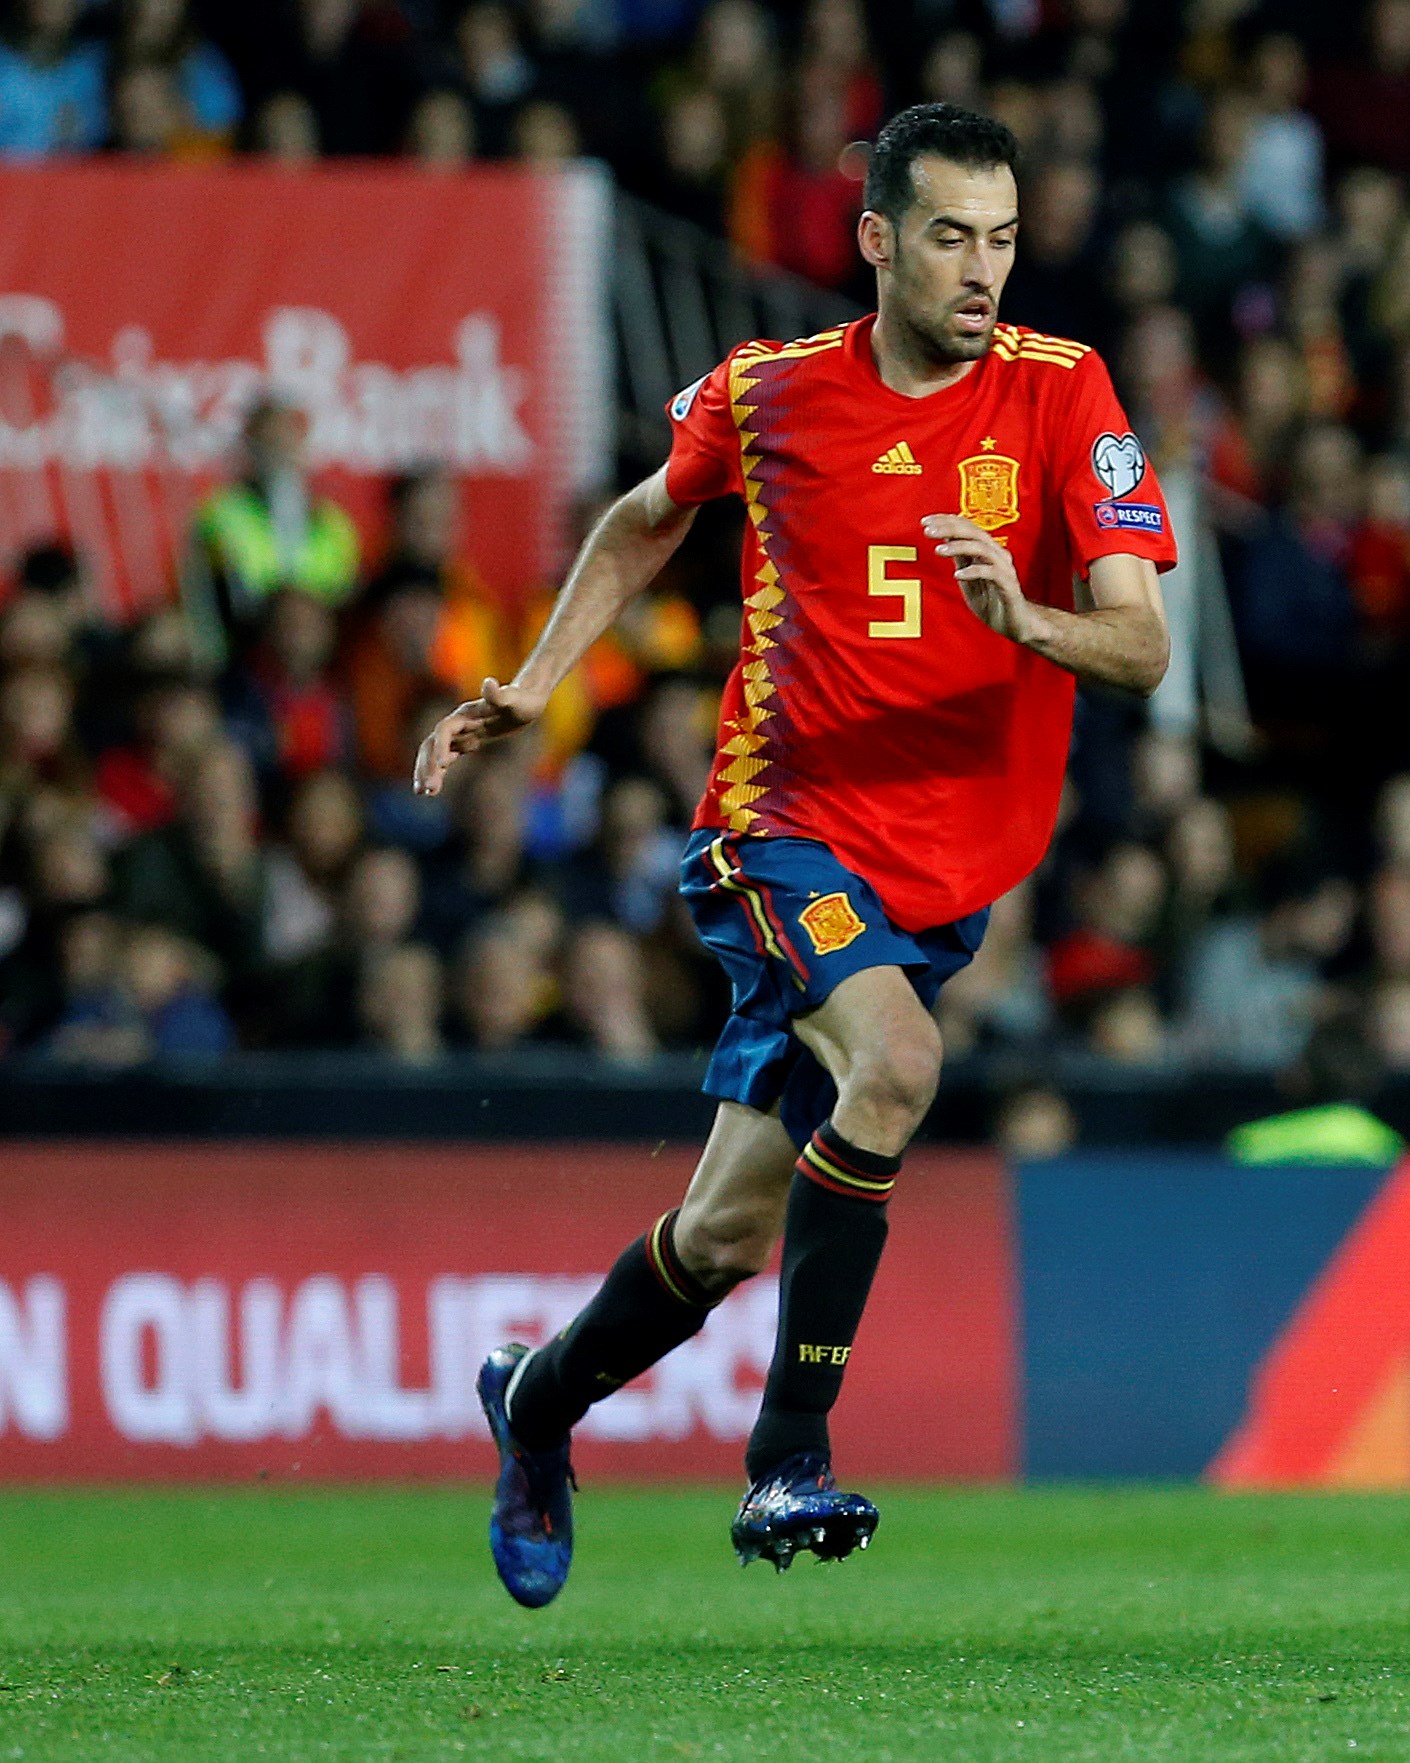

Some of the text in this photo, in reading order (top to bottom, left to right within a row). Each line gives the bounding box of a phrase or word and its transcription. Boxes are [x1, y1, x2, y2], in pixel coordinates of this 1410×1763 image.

[871, 462, 923, 475] adidas
[1117, 509, 1162, 526] RESPECT
[867, 545, 923, 638] 5
[99, 1272, 782, 1447] QUALIFRS
[799, 1344, 852, 1366] RFEF
